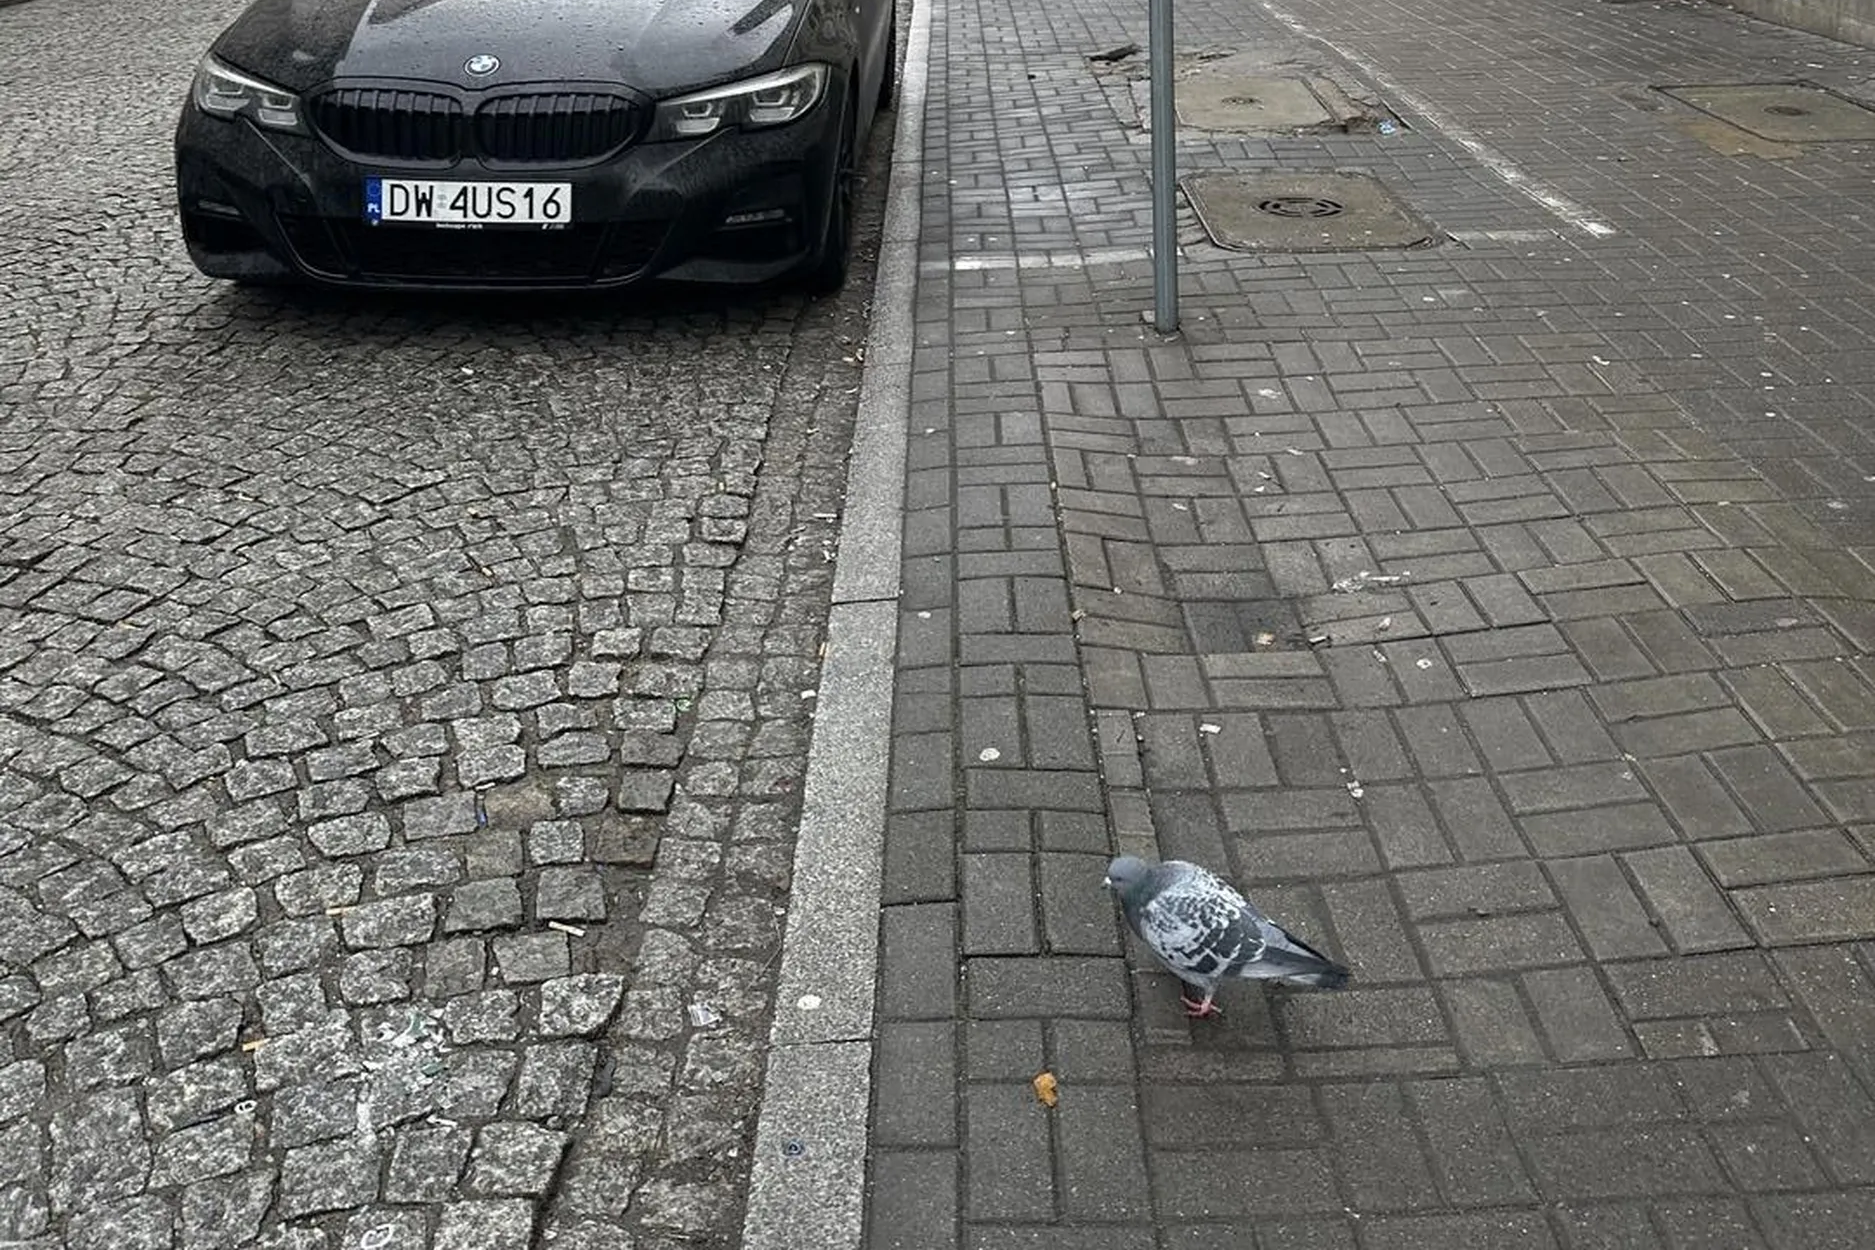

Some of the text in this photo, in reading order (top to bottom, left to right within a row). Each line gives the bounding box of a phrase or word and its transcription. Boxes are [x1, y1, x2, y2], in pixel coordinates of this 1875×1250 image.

[367, 202, 380, 213] PL
[390, 183, 561, 219] DW 4US16
